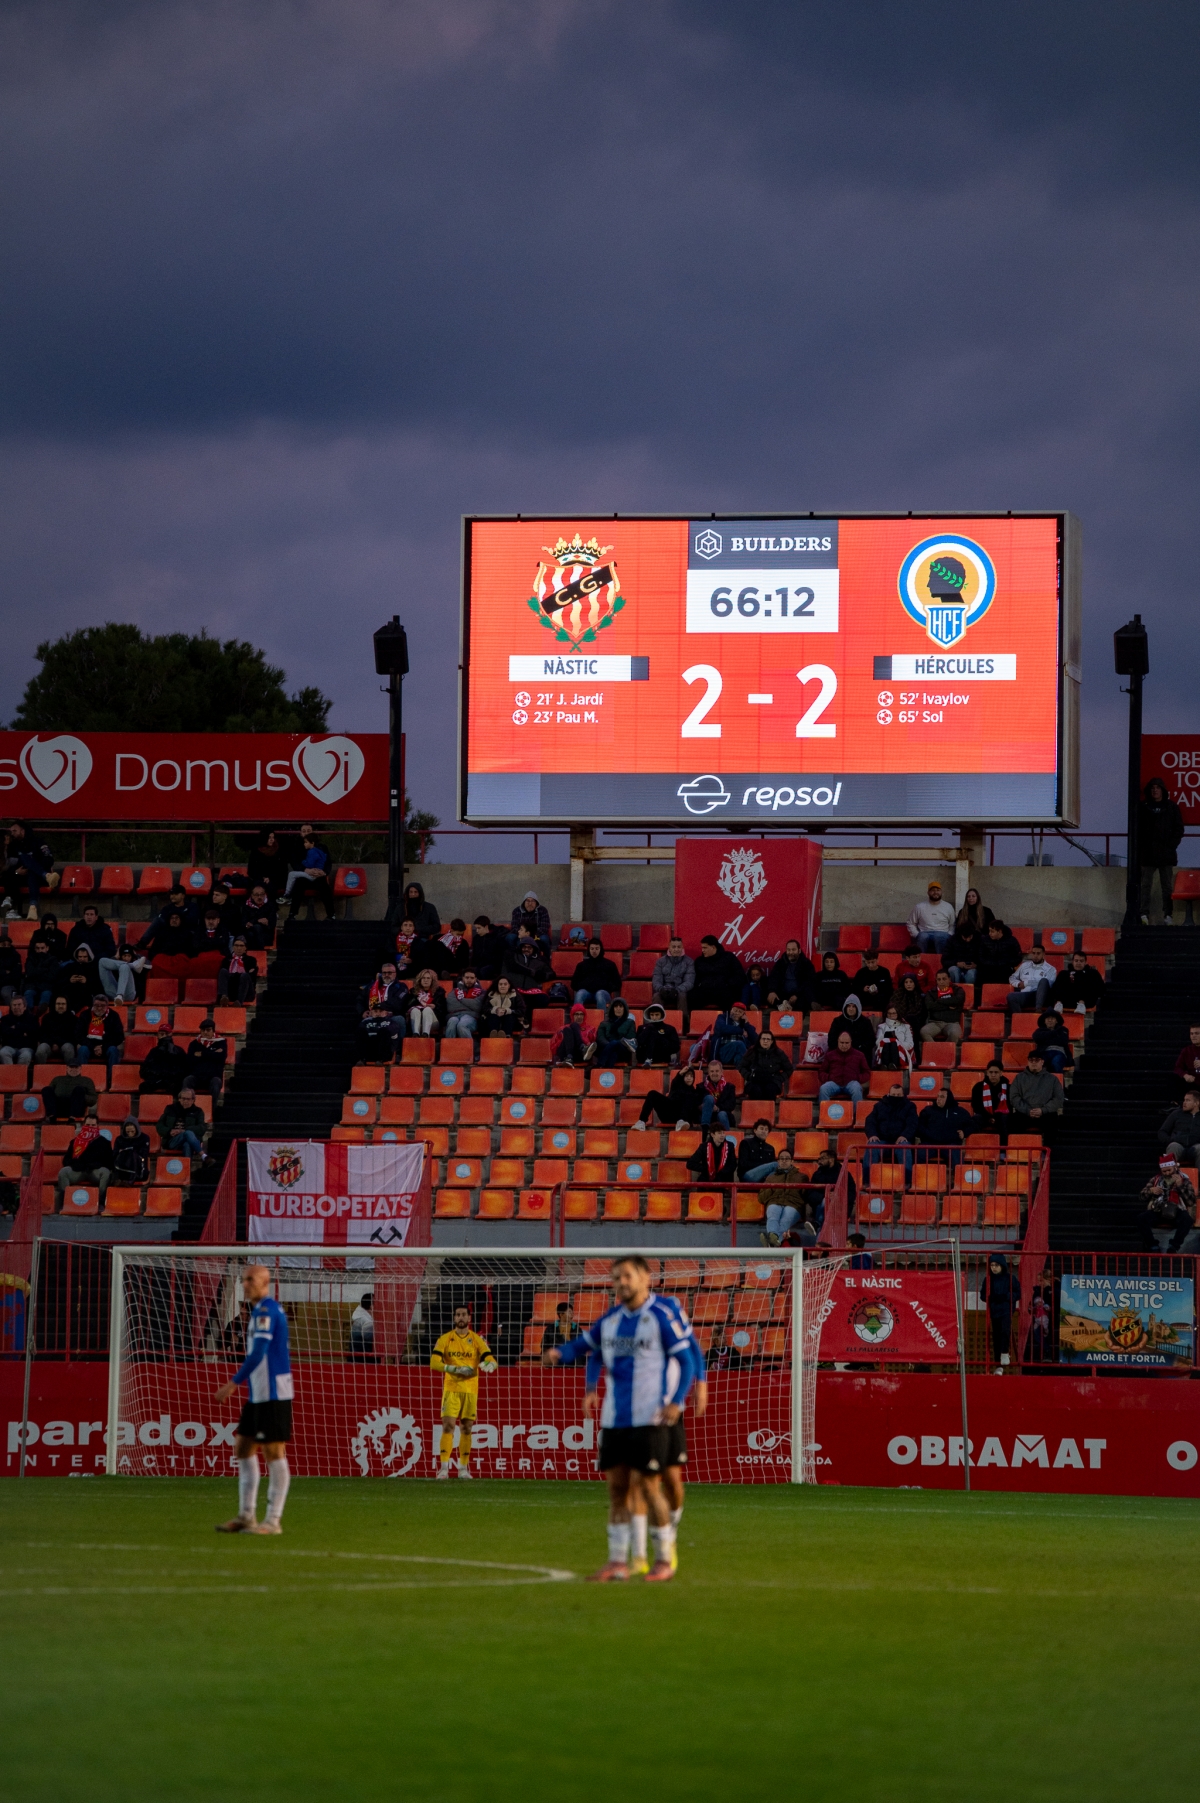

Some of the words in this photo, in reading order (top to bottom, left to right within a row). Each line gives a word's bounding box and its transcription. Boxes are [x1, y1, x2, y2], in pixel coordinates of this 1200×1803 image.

[731, 537, 831, 552] BUILDERS
[710, 586, 815, 617] 66:12
[932, 608, 961, 643] HCF
[543, 657, 598, 675] NÀSTIC
[914, 656, 995, 674] HÉRCULES
[556, 693, 568, 706] J.
[570, 692, 604, 706] Jardí
[681, 664, 723, 738] 2
[748, 693, 773, 704] -
[795, 663, 838, 738] 2
[922, 692, 970, 708] Ivaylov
[557, 711, 581, 724] Pau
[584, 711, 599, 724] M.
[922, 710, 943, 723] Sol
[1161, 751, 1200, 768] OBE
[742, 782, 842, 810] repsol
[744, 950, 781, 962] Vidal
[257, 1194, 412, 1218] TURBOPETATS
[845, 1277, 857, 1288] EL
[862, 1275, 902, 1289] NÀSTIC
[1071, 1279, 1112, 1290] PENYA
[1115, 1280, 1156, 1291] AMICS
[1160, 1281, 1183, 1292] DEL
[1088, 1290, 1163, 1309] NÀSTIC
[817, 1298, 837, 1323] COR
[909, 1300, 919, 1310] A
[916, 1309, 928, 1323] LA
[925, 1320, 947, 1349] SANG
[1086, 1353, 1115, 1362] AMOR
[1118, 1354, 1128, 1362] ET
[1131, 1354, 1166, 1363] FORTIA
[432, 1418, 603, 1456] parad
[736, 1455, 773, 1464] COSTA
[776, 1456, 832, 1465] DARADA
[887, 1434, 1107, 1469] OBRAMAT
[432, 1457, 600, 1472] INTERACT
